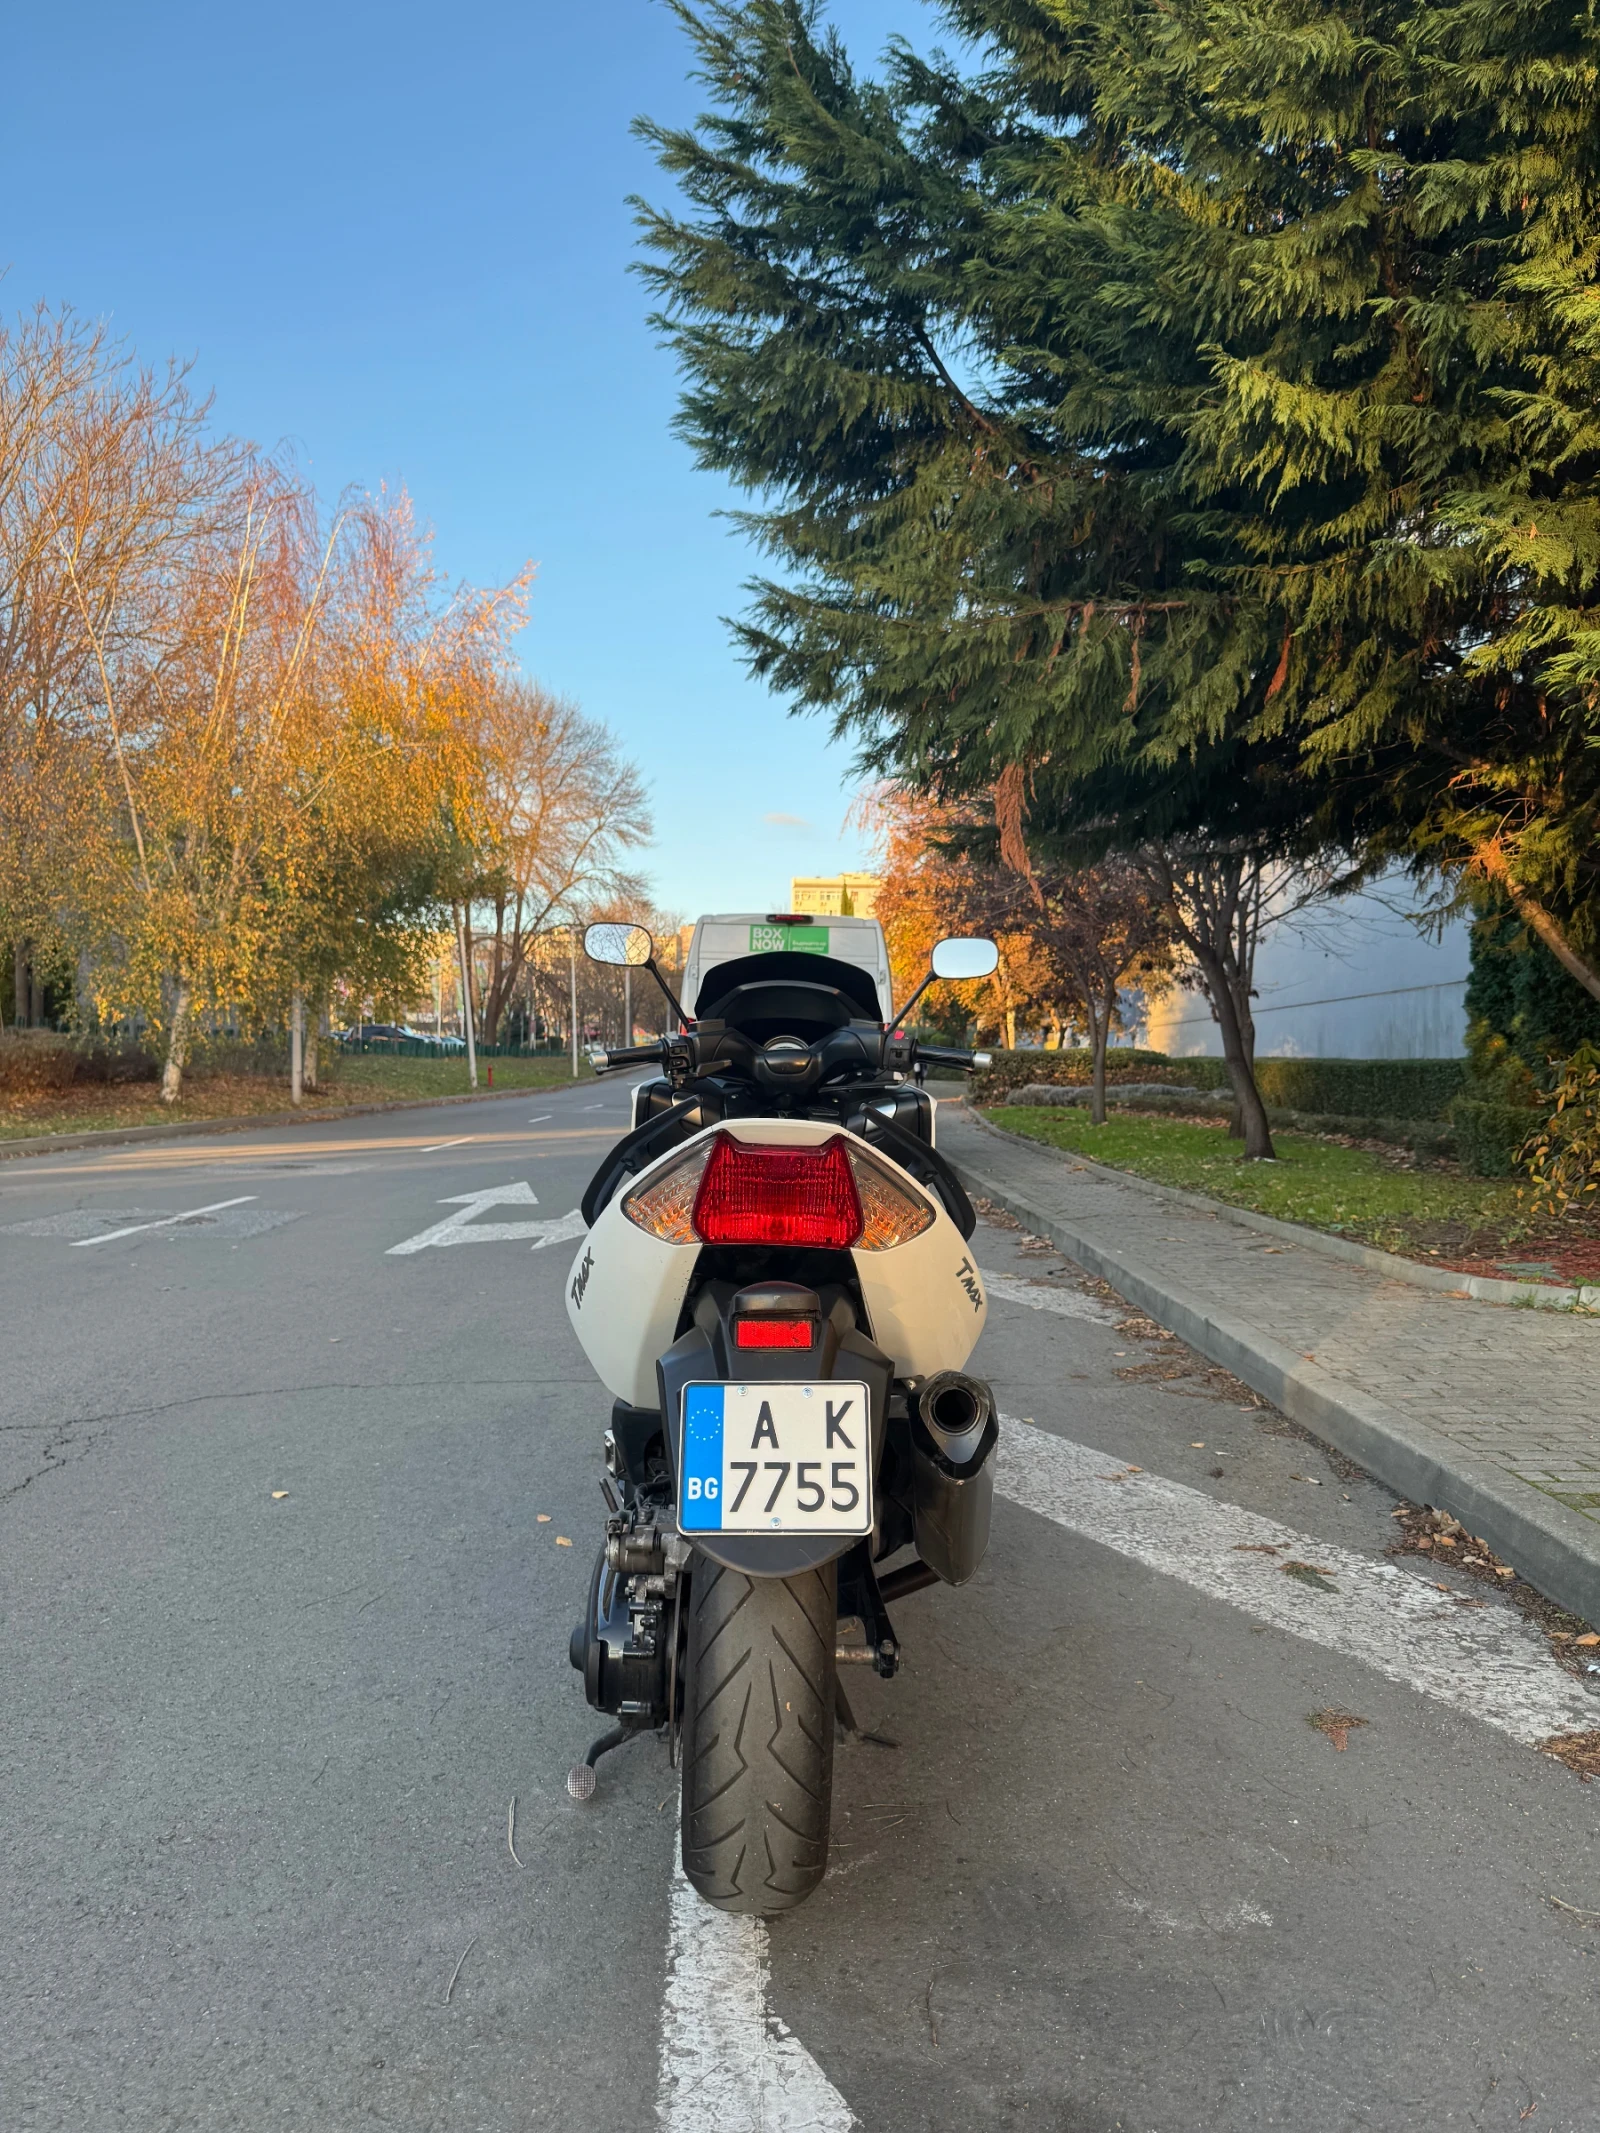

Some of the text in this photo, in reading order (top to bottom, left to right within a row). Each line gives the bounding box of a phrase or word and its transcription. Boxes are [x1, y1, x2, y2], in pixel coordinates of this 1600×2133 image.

[752, 939, 785, 951] NOW
[753, 927, 783, 939] BOX
[750, 1400, 857, 1449] A K
[687, 1476, 719, 1500] BG
[729, 1461, 860, 1513] 7755
